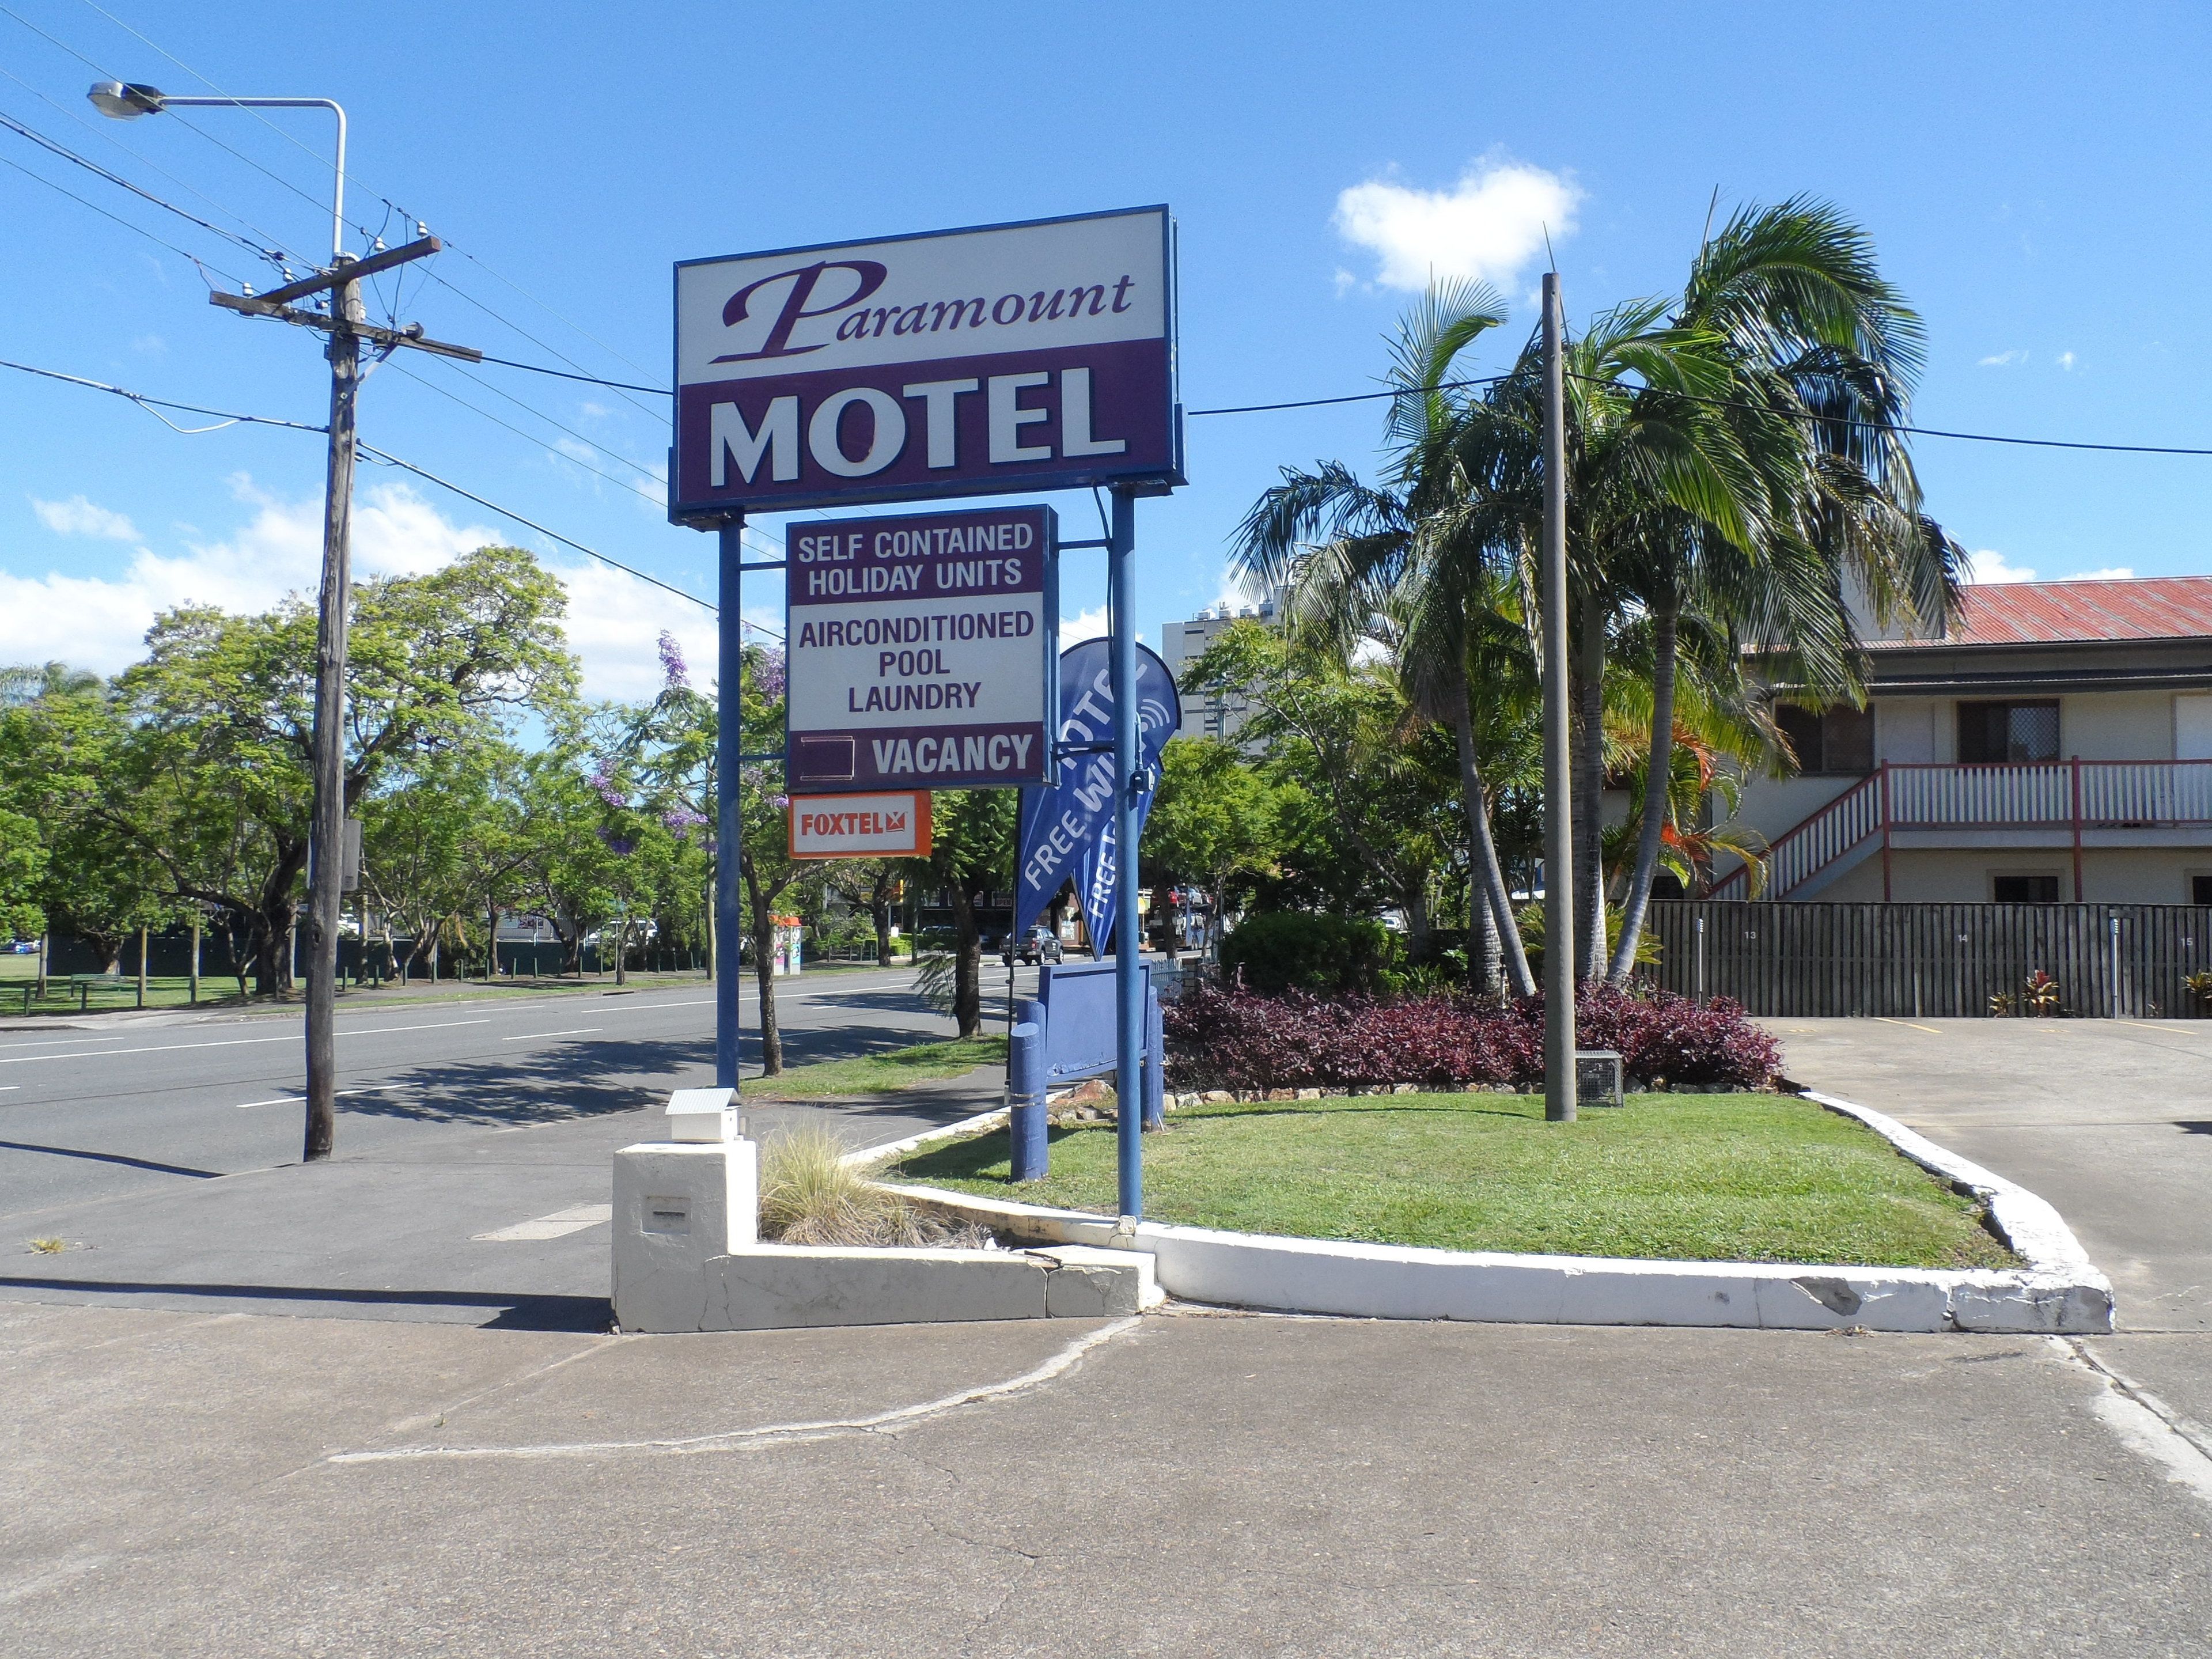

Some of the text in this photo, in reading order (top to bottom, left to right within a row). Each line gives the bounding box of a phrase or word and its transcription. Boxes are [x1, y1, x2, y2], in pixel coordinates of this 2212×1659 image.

[707, 260, 1135, 365] Paramount
[709, 367, 1127, 488] MOTEL
[798, 524, 1033, 562] SELF CONTAINED
[809, 558, 1022, 596] HOLIDAY UNITS
[799, 611, 1034, 647] AIRCONDITIONED
[880, 649, 950, 677] POOL
[849, 682, 982, 712] LAUNDRY
[872, 734, 1033, 774] VACANCY
[801, 812, 884, 836] FOXTEL
[1024, 809, 1086, 891] FREE
[1957, 934, 1968, 942] 14
[2180, 938, 2194, 947] 15
